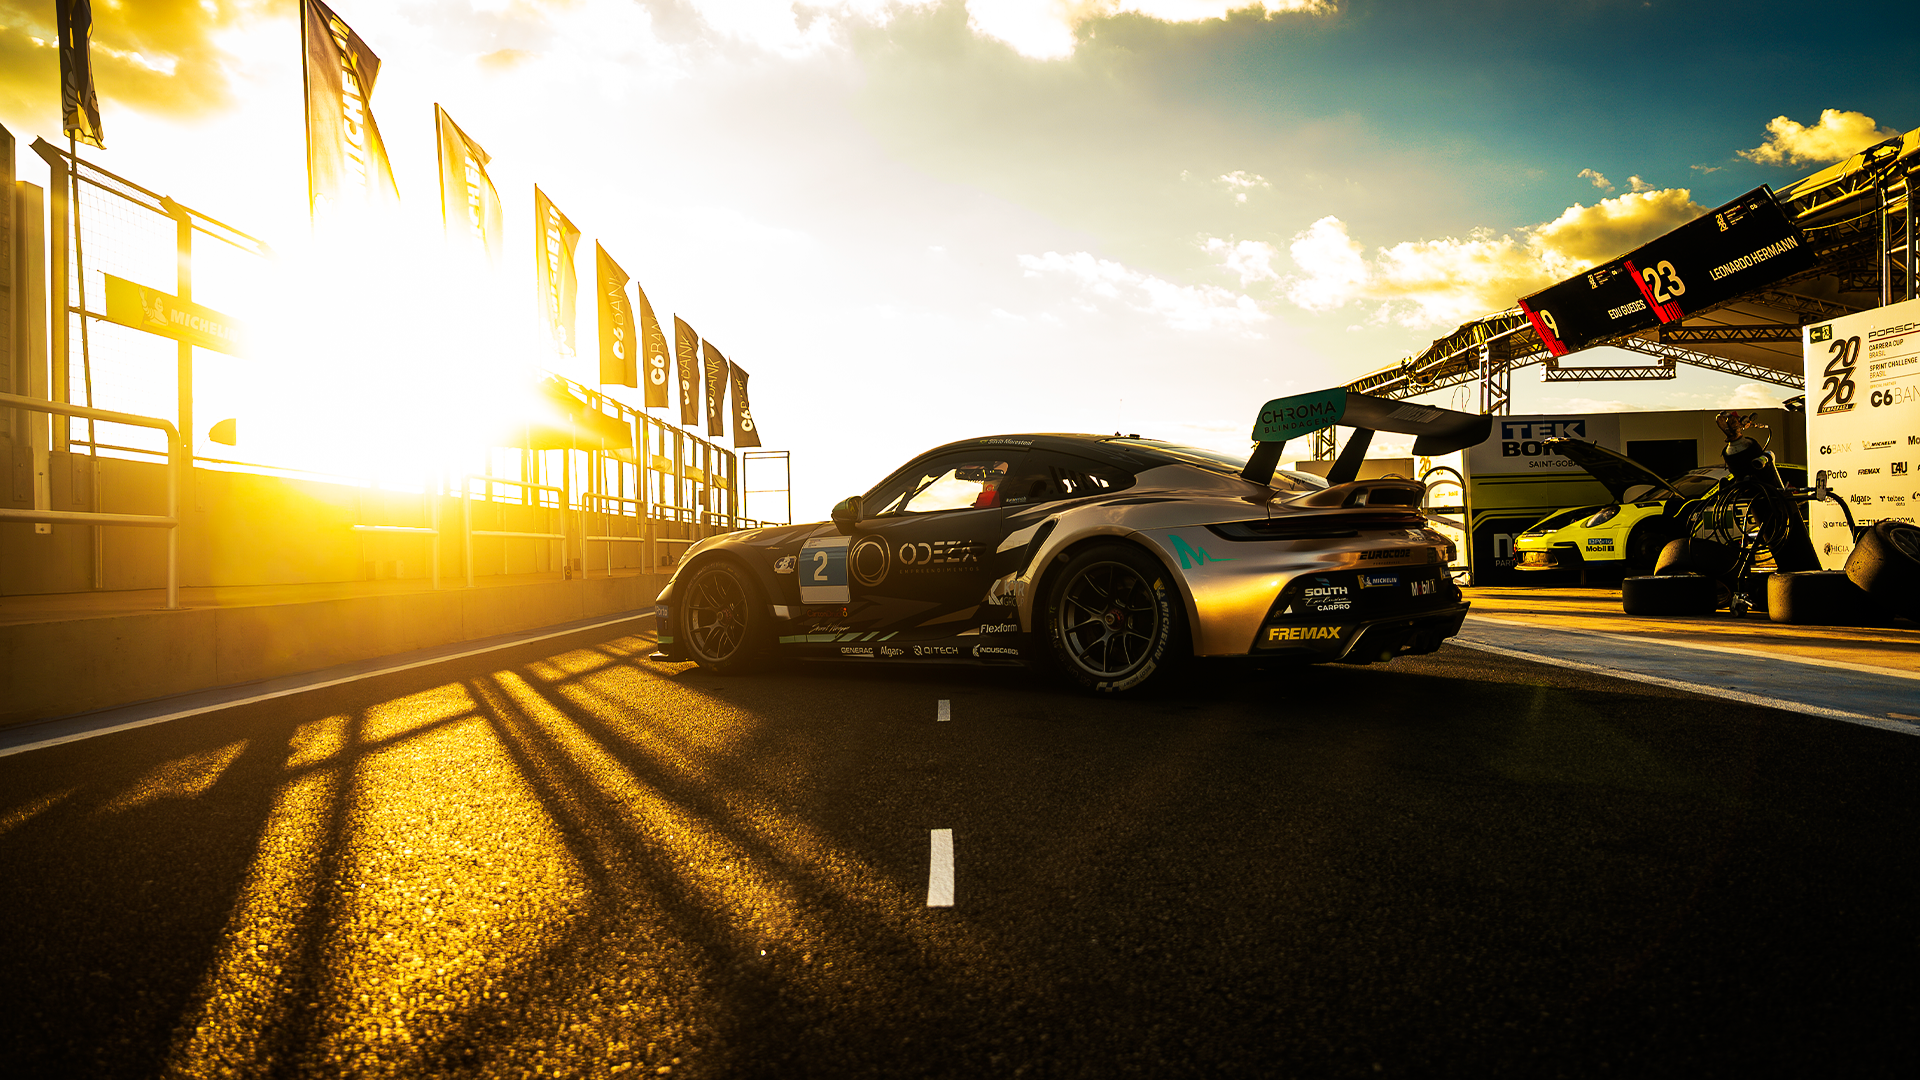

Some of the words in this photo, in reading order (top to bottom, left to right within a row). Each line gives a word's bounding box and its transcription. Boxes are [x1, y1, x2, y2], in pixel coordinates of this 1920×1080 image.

[1709, 255, 1754, 282] LEONARDO
[1750, 235, 1799, 265] HERMANN
[1642, 260, 1686, 304] 23
[1607, 307, 1623, 320] EDU
[1620, 299, 1647, 316] GUEDES
[170, 309, 240, 343] MICHELIN
[1540, 309, 1560, 339] 9
[1868, 340, 1893, 352] CARRERA
[1892, 338, 1904, 347] CUP
[1869, 362, 1888, 372] SPRINT
[1887, 356, 1918, 368] CHALLENGE
[1261, 401, 1337, 424] CHROMA
[1264, 415, 1336, 433] BLINDAGENS
[1505, 422, 1583, 440] TEK
[1827, 469, 1848, 479] Porto
[1857, 467, 1881, 475] FREMAX
[1891, 461, 1908, 474] D4U
[813, 550, 829, 581] 2
[1305, 587, 1348, 597] SOUTH
[1411, 580, 1430, 597] Mobil
[1317, 603, 1351, 611] CARPRO
[980, 622, 1018, 633] Flexform
[1153, 600, 1171, 661] MICHELIN
[1268, 626, 1342, 641] FREMAX
[980, 646, 1019, 655] INDUSCABOS
